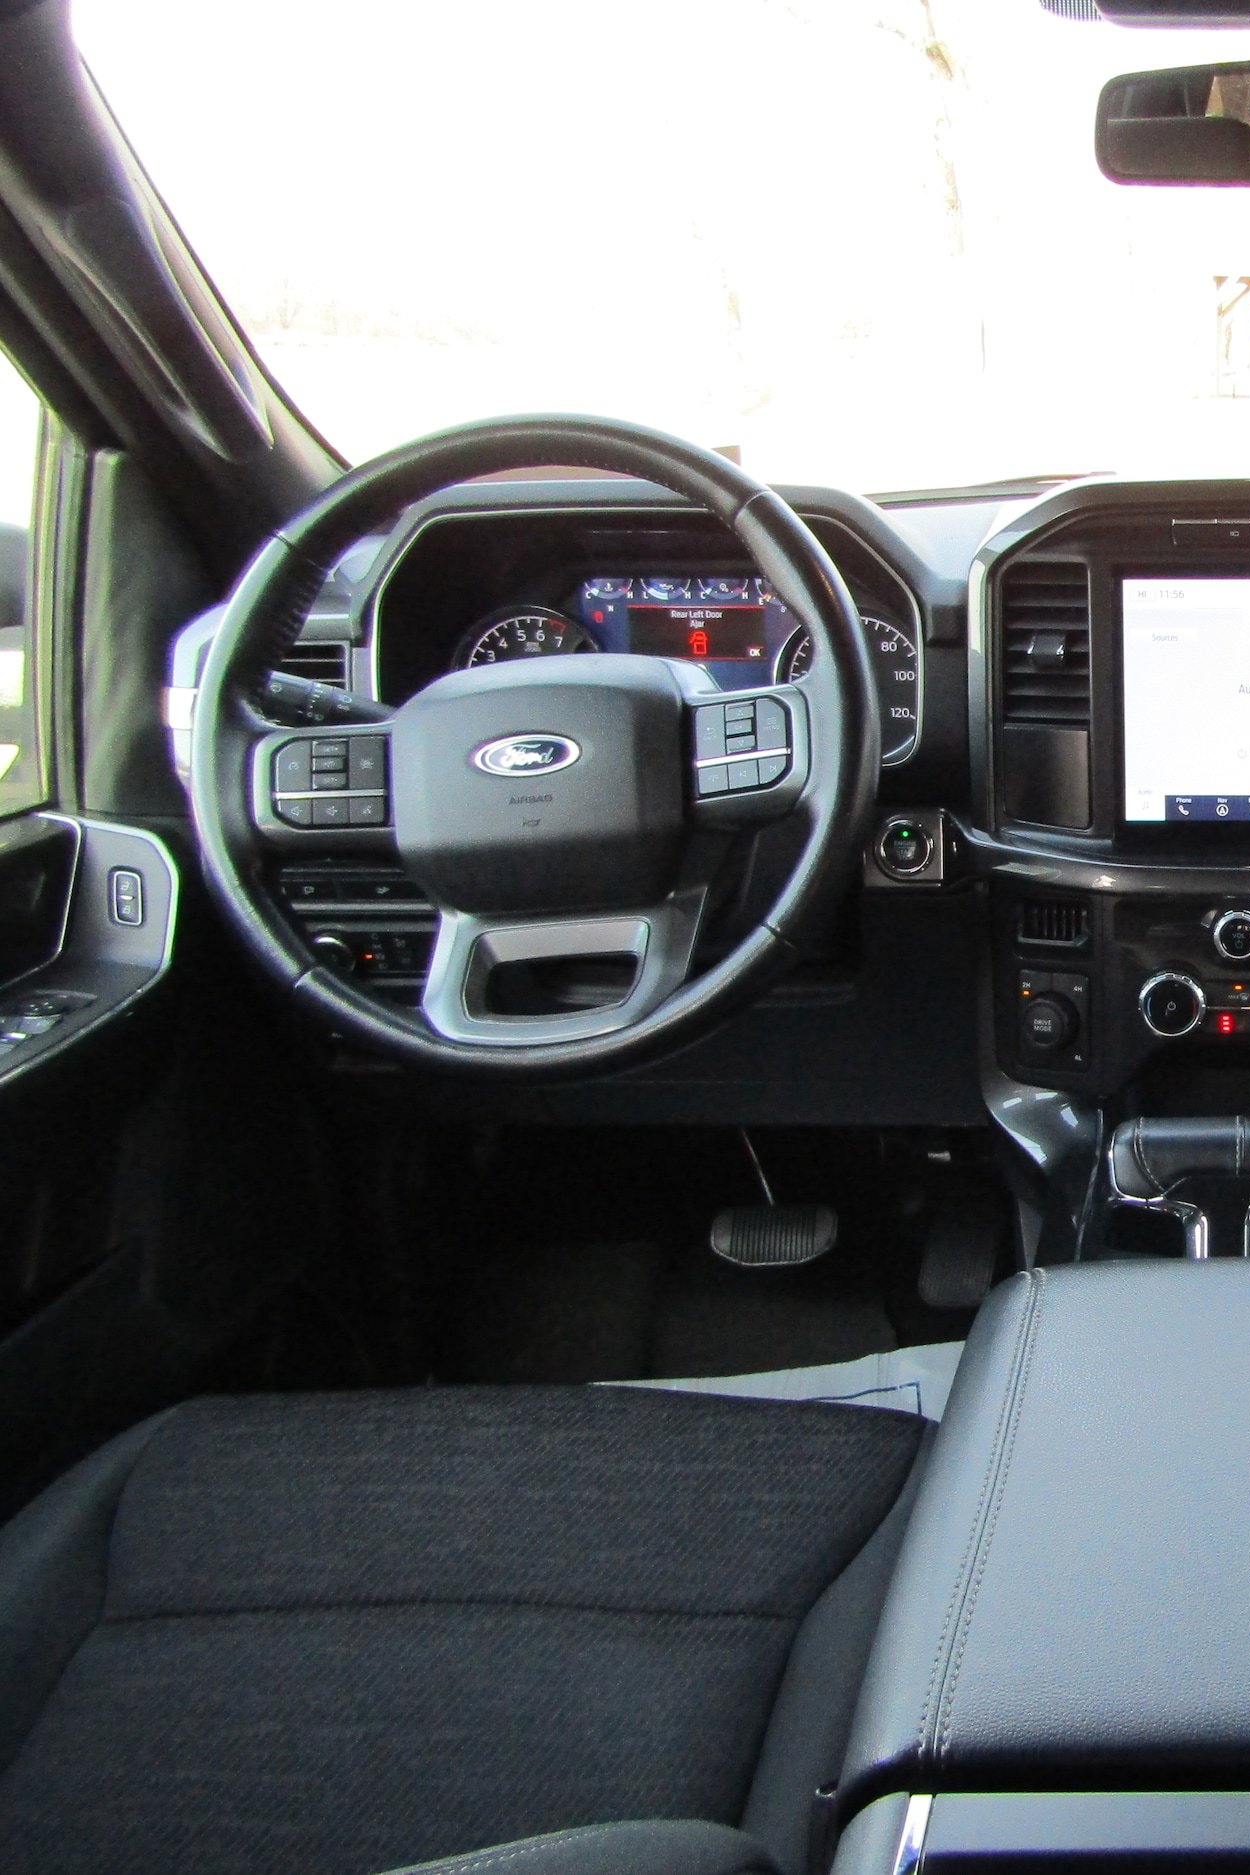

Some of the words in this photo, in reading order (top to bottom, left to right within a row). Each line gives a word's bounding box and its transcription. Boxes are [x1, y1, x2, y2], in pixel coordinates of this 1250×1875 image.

[627, 592, 634, 600] H
[684, 592, 692, 600] H
[742, 592, 748, 600] H
[1138, 590, 1147, 598] HI
[1159, 590, 1185, 599] 11:56
[671, 610, 687, 618] Rear
[689, 610, 704, 618] Left
[706, 610, 722, 618] Door
[690, 620, 704, 628] Ajar
[517, 630, 527, 642] 5
[536, 630, 546, 642] 6
[1151, 633, 1179, 642] Sources
[499, 639, 508, 649] 4
[554, 636, 564, 648] 7
[881, 641, 898, 652] 80
[487, 650, 496, 662] 3
[749, 648, 761, 657] OK
[894, 670, 916, 682] 100
[890, 707, 910, 718] 120
[499, 743, 554, 769] Ford
